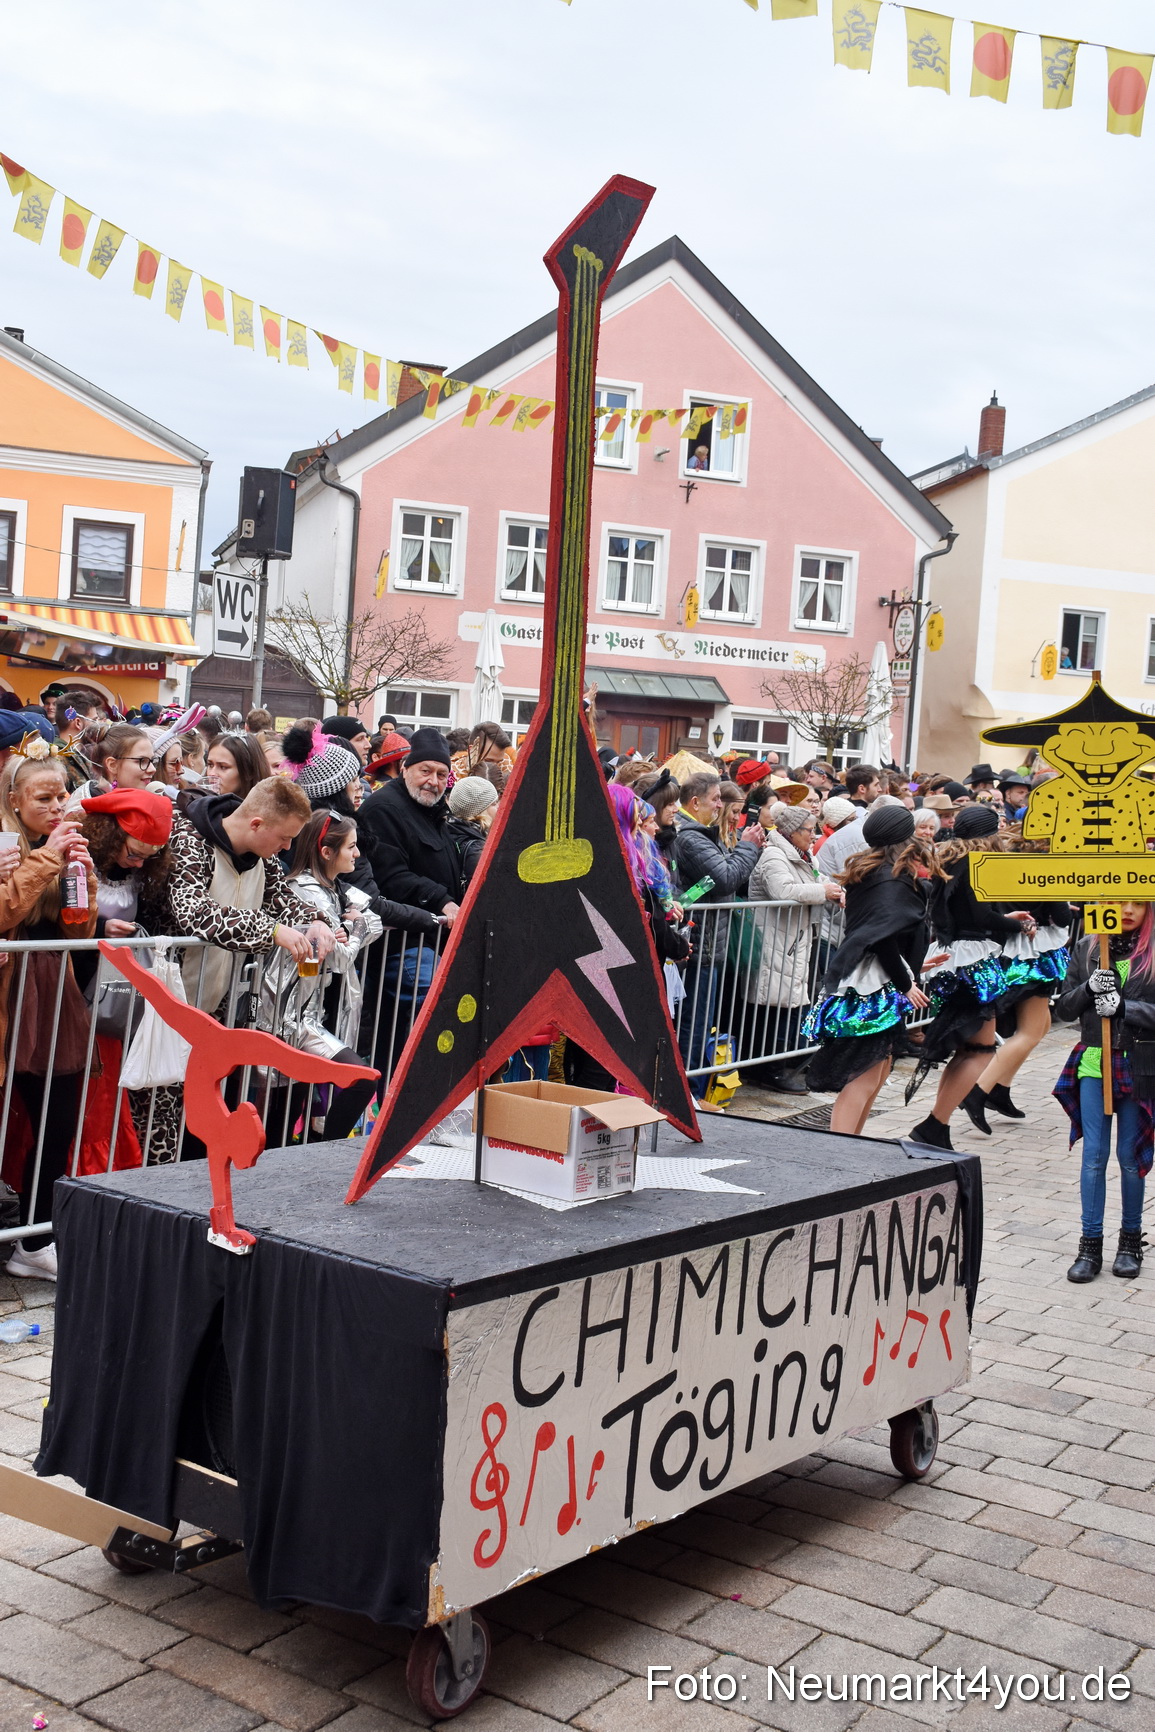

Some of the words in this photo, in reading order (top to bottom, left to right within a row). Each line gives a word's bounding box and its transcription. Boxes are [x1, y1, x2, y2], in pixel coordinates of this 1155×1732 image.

[216, 578, 254, 622] WC
[500, 622, 543, 640] Gast
[604, 631, 645, 651] Post
[694, 640, 789, 663] Niedermeier
[1018, 872, 1121, 887] Jugendgarde
[1086, 908, 1118, 930] 16
[512, 1192, 964, 1408] CHIMICHANGA
[600, 1337, 844, 1527] Töging
